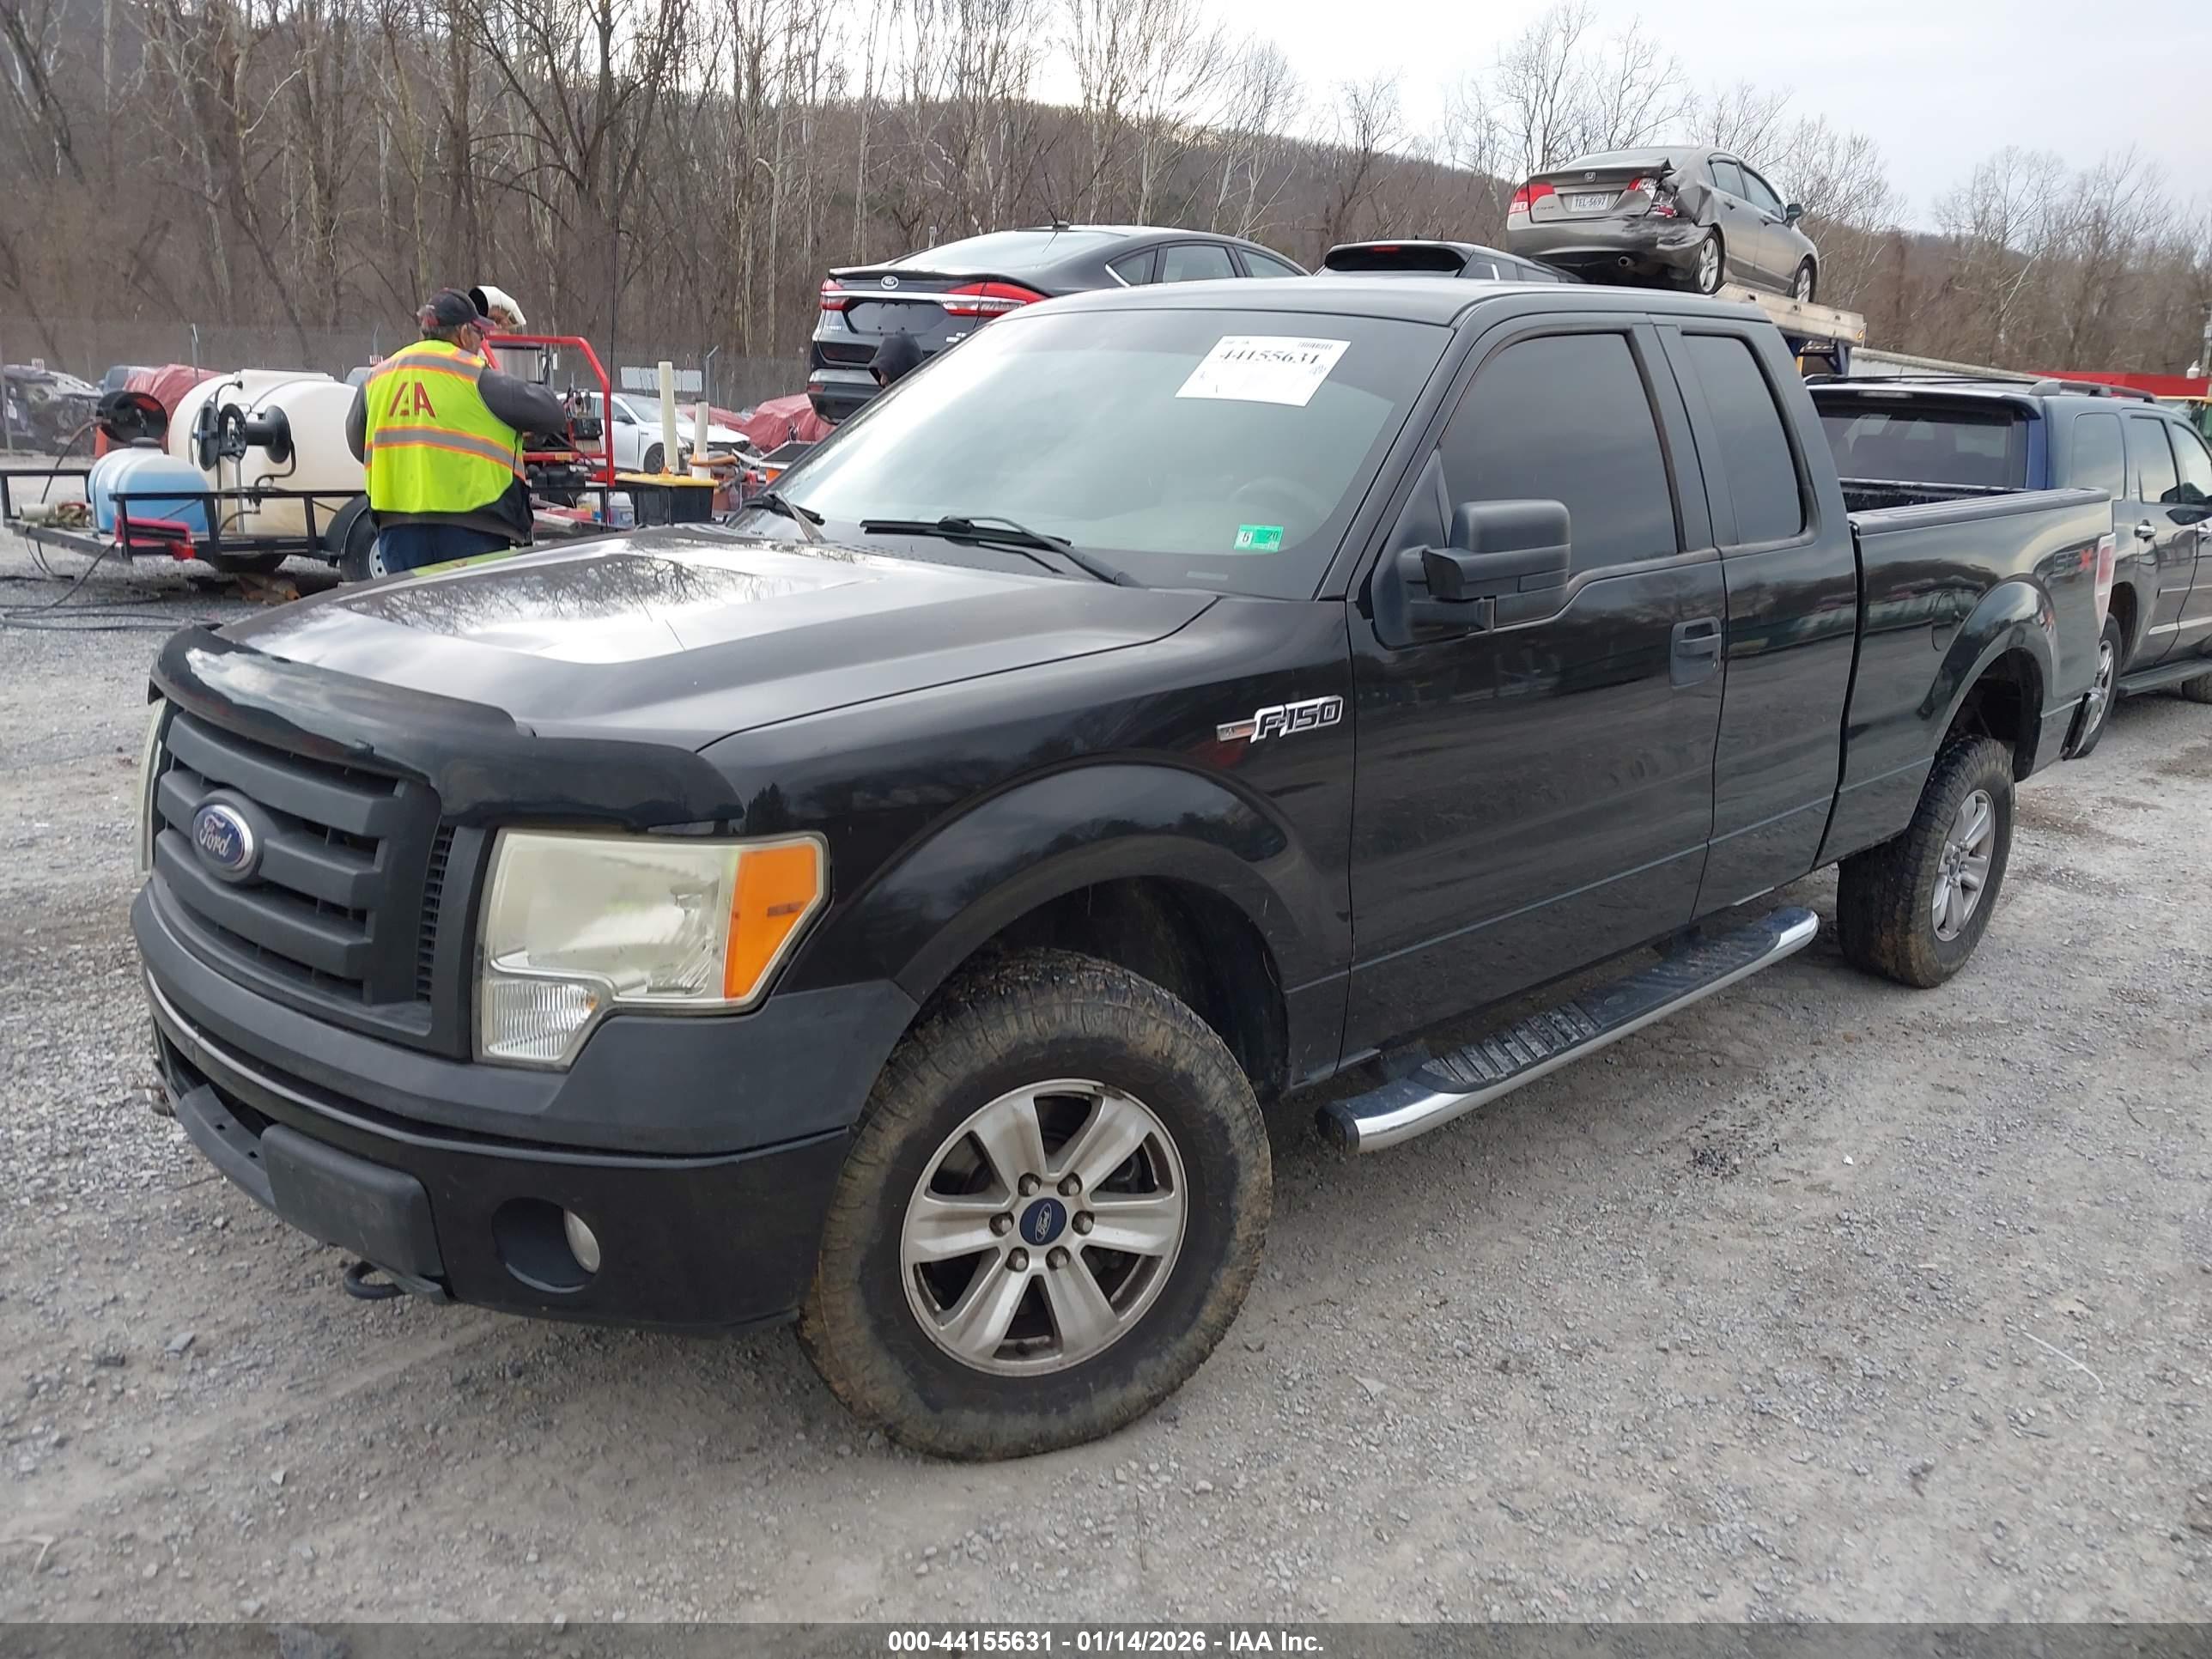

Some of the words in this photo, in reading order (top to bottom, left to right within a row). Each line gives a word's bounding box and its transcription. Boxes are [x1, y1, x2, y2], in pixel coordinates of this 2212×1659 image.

[1250, 695, 1344, 744] F-150
[199, 814, 233, 858] Ford
[1037, 1210, 1050, 1237] Ford
